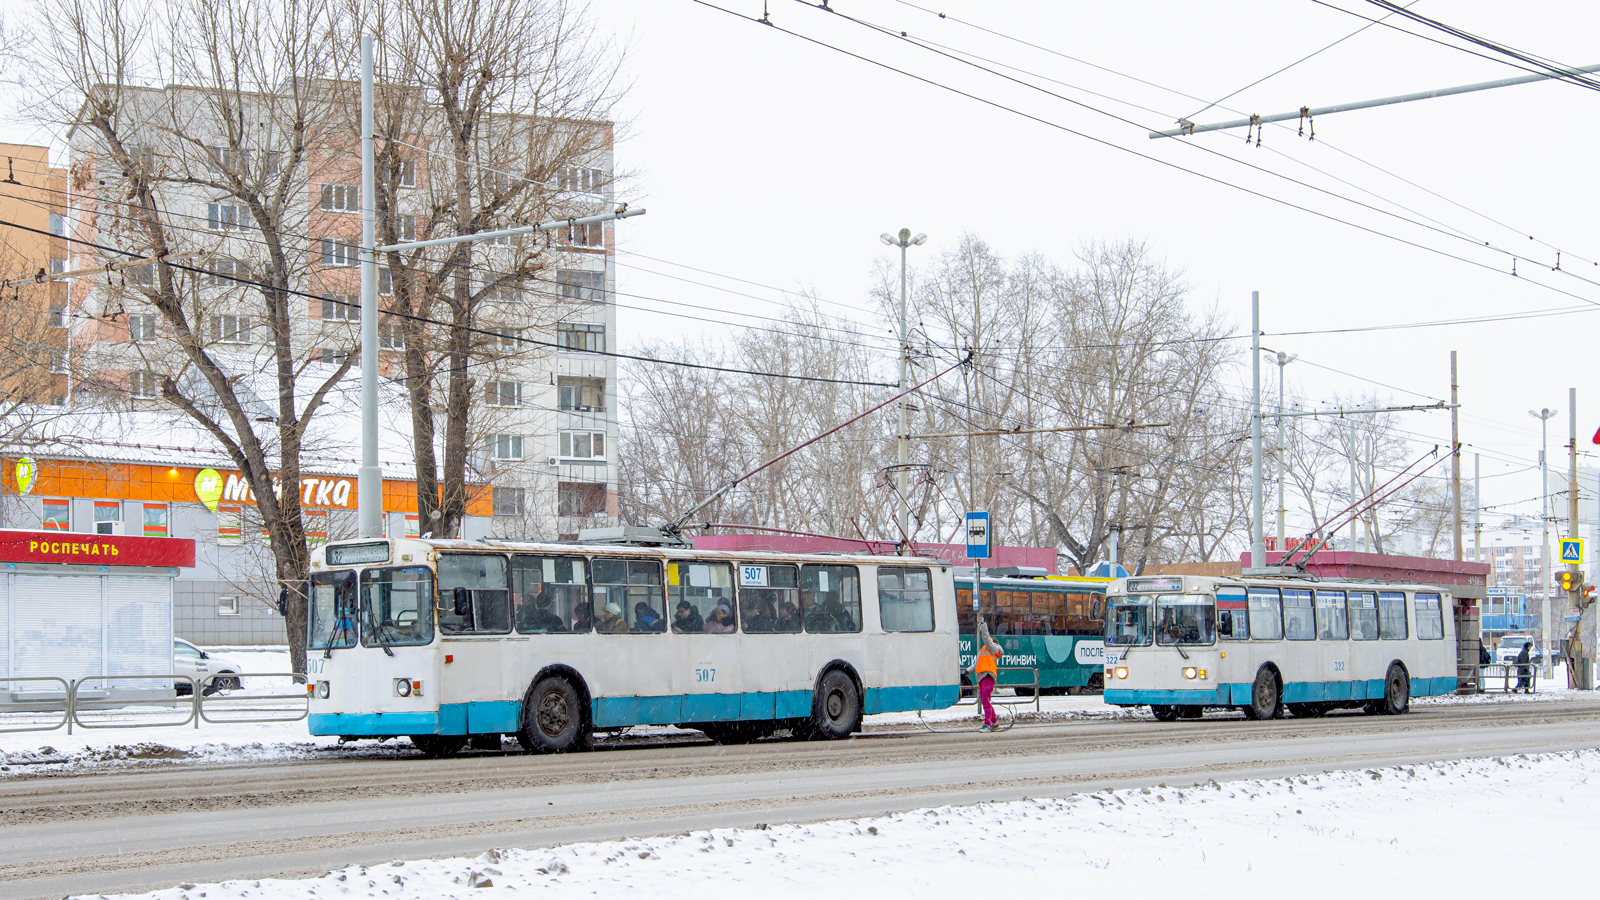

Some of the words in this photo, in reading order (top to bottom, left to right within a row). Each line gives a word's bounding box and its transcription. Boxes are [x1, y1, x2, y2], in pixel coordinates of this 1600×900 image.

[30, 541, 119, 556] РОСПЕЧАТЬ
[745, 567, 762, 580] 507
[1002, 654, 1037, 665] ГРИНВИЧ
[1105, 656, 1118, 665] 322
[1334, 661, 1345, 672] 322
[695, 668, 716, 683] 507
